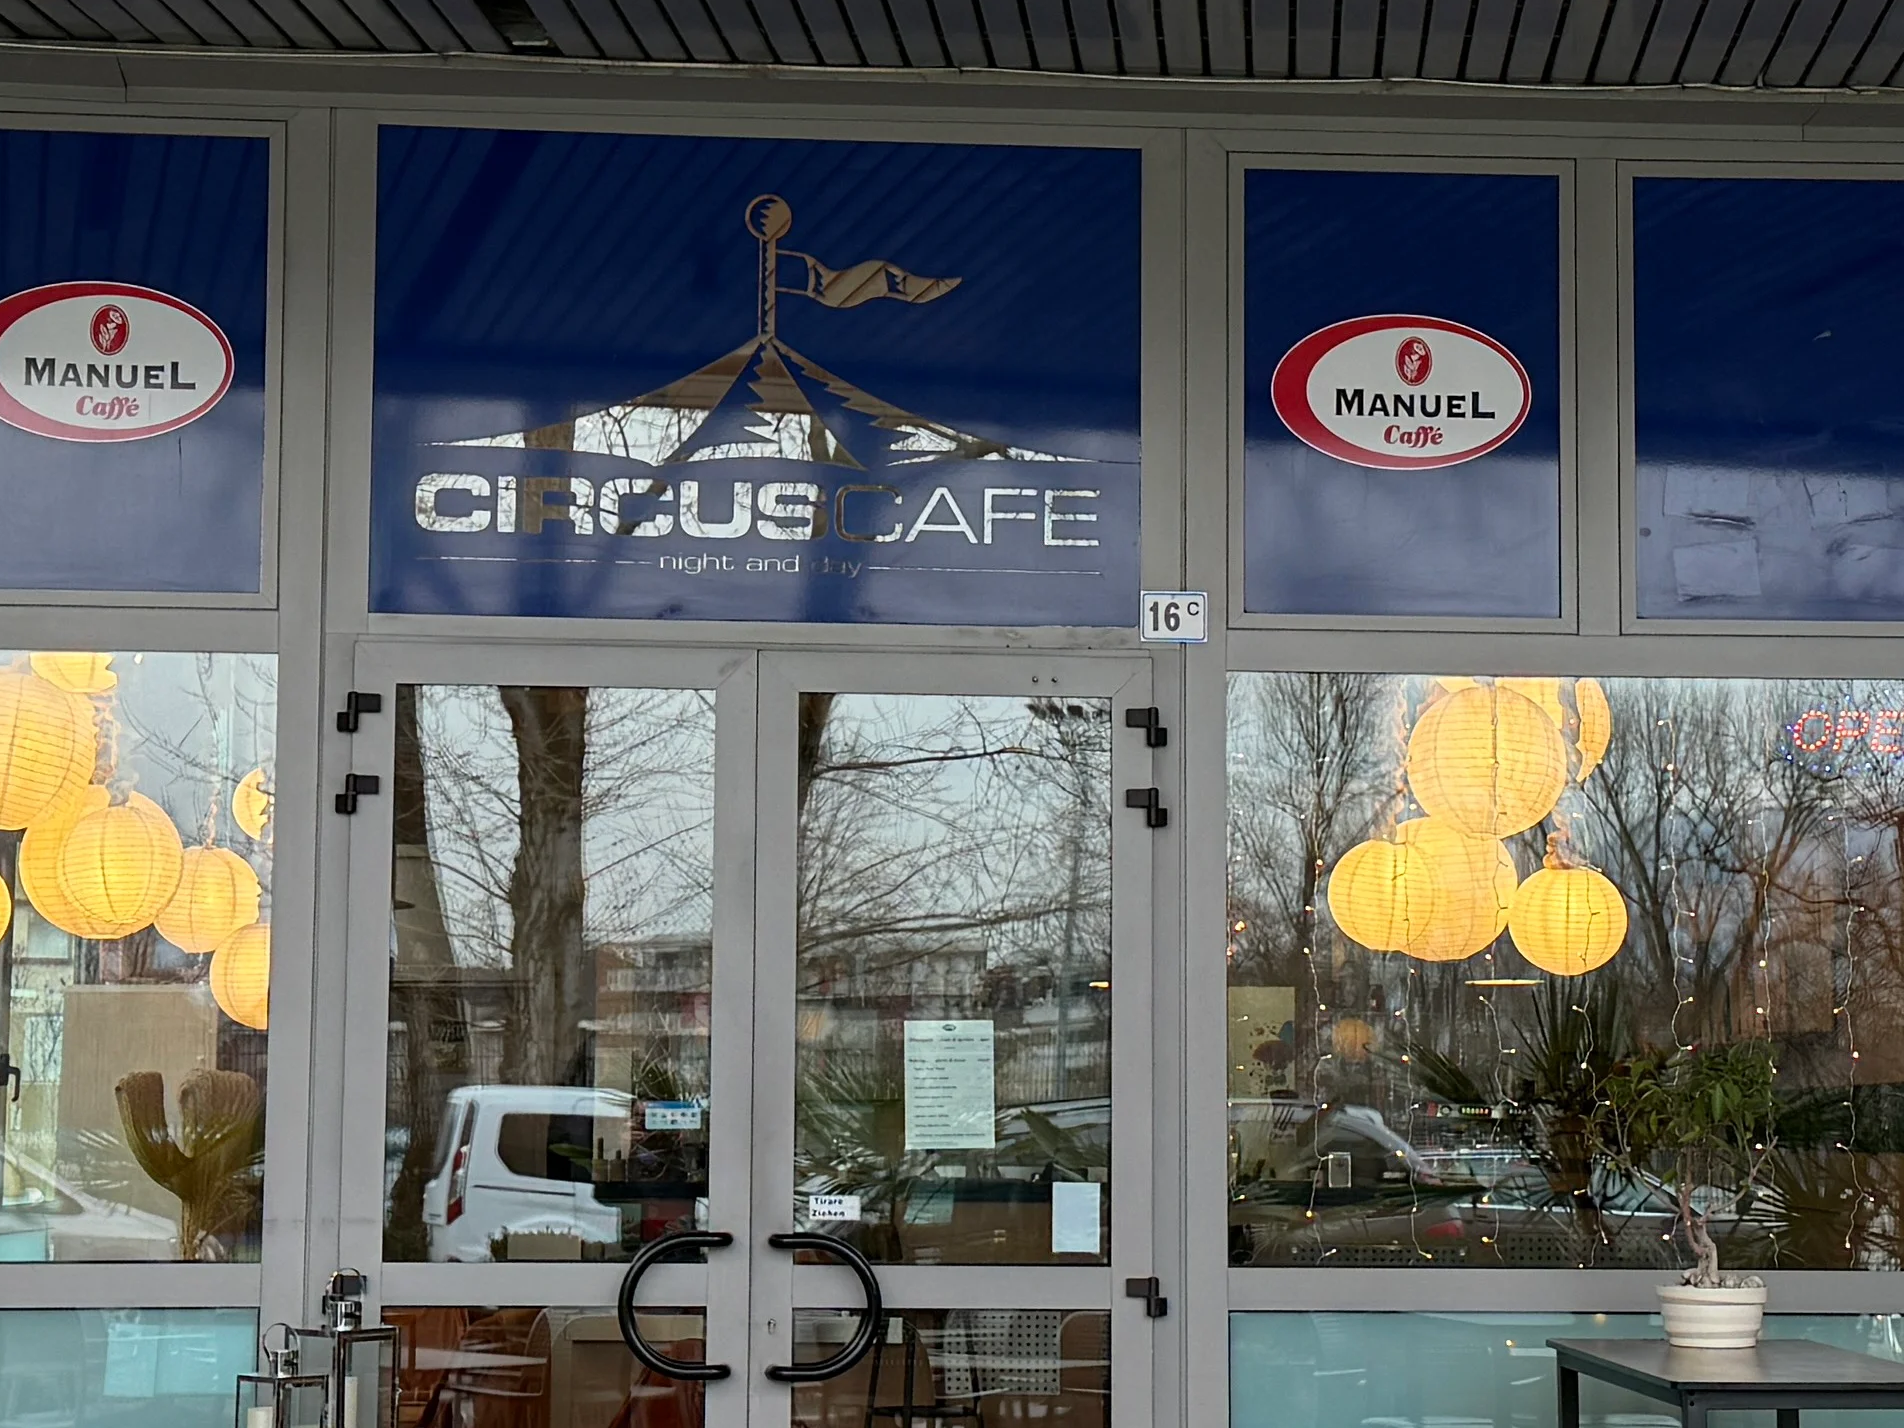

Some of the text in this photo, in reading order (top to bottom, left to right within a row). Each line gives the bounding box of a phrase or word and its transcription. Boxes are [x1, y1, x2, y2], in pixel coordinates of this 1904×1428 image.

[24, 357, 196, 390] MANUEL
[75, 395, 140, 420] Caffé
[1335, 388, 1495, 419] MANUEL
[1383, 424, 1444, 448] Caffé
[659, 553, 734, 575] night
[746, 555, 800, 572] and
